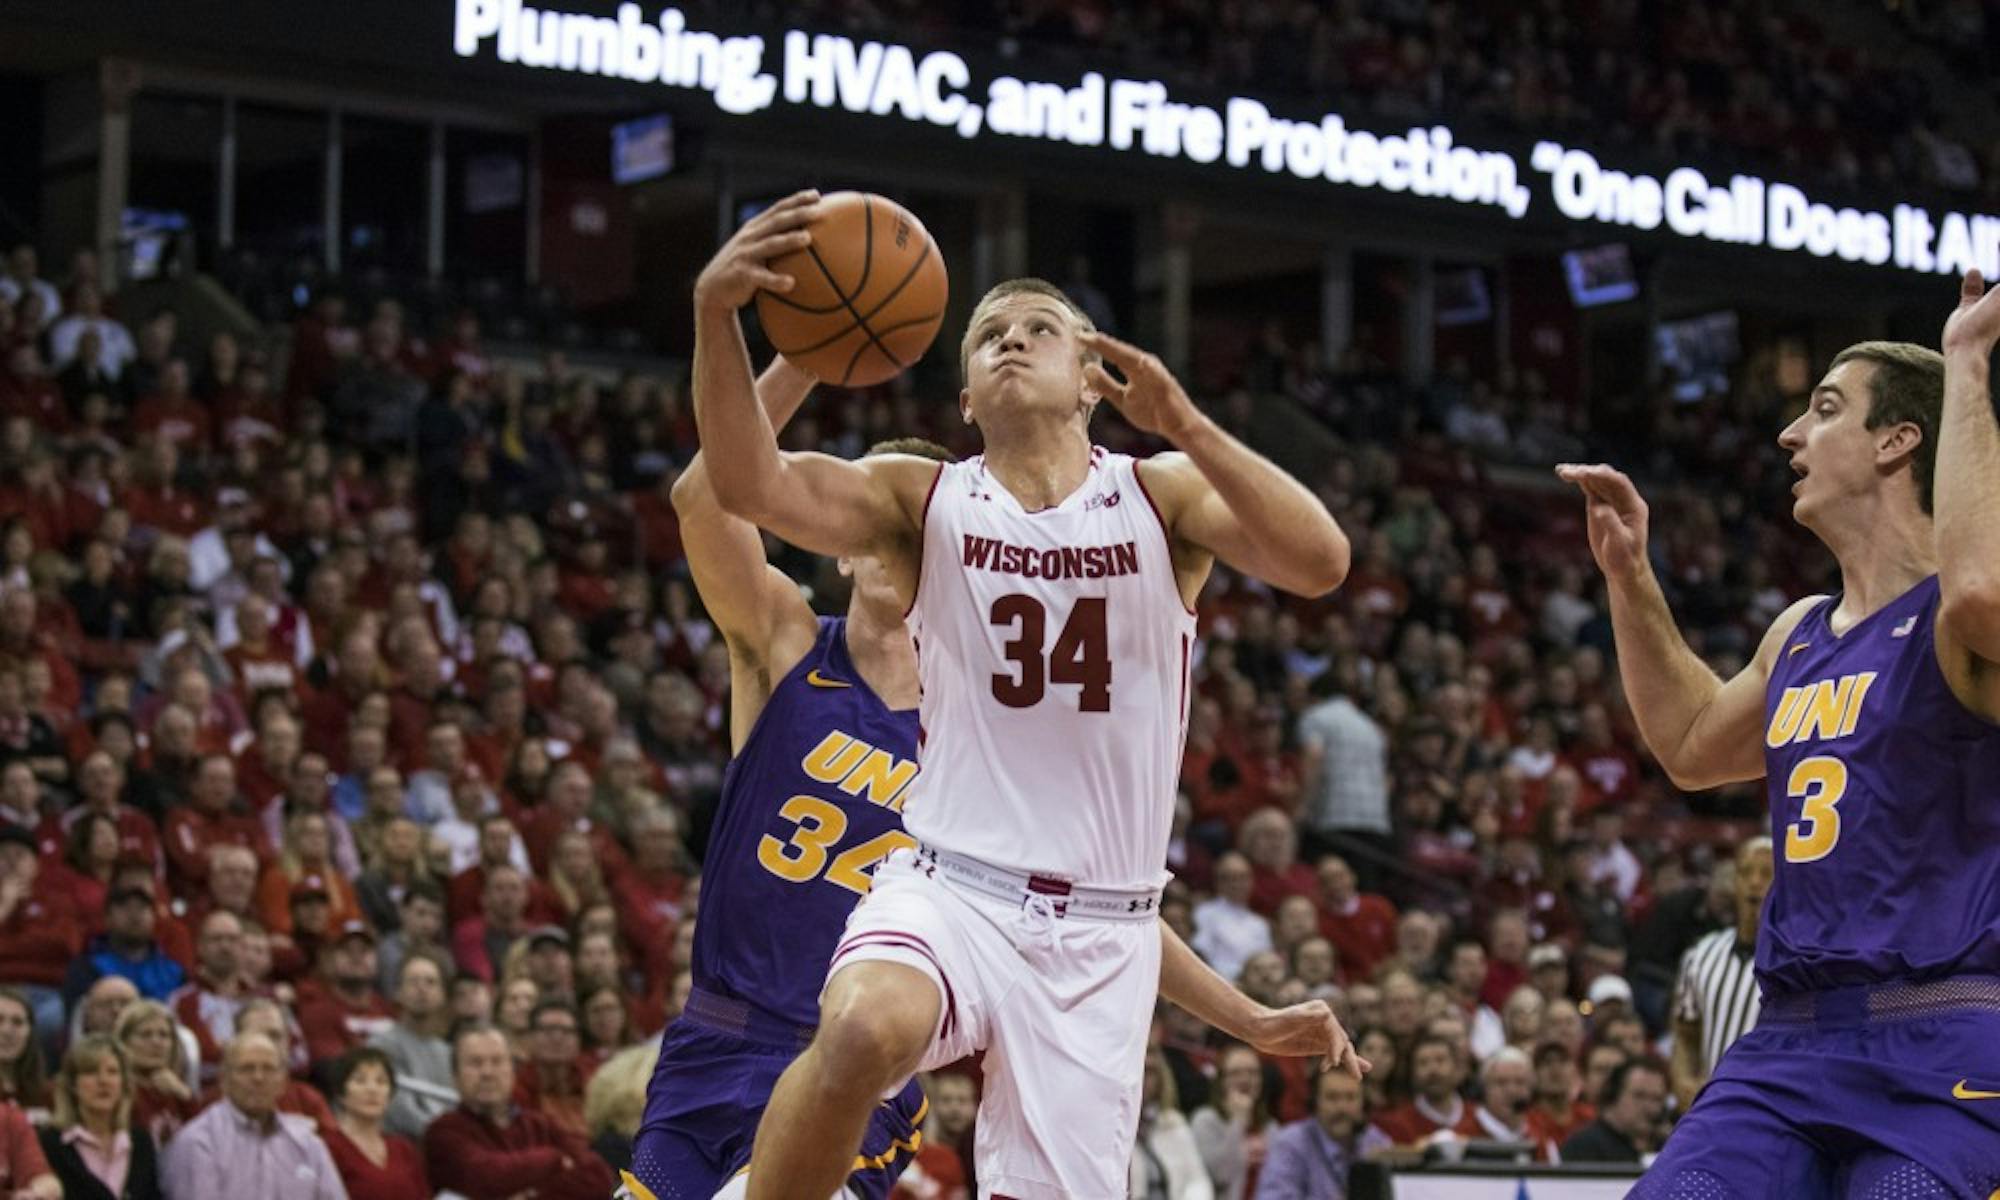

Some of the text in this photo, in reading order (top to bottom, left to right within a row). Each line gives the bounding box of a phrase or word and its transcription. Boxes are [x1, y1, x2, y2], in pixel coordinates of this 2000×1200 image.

[455, 0, 777, 113] Plumbing,
[784, 31, 983, 137] HVAC,
[987, 73, 1104, 145] and
[1110, 80, 1223, 162] Fire
[1227, 98, 1530, 217] Protection,
[1664, 167, 1764, 244] Call
[1768, 184, 1891, 264] Does
[1893, 204, 1935, 272] It
[963, 534, 1139, 580] WISCONSIN
[990, 594, 1112, 713] 34
[1766, 672, 1878, 749] UNI
[801, 730, 921, 815] UN
[1785, 756, 1848, 863] 3
